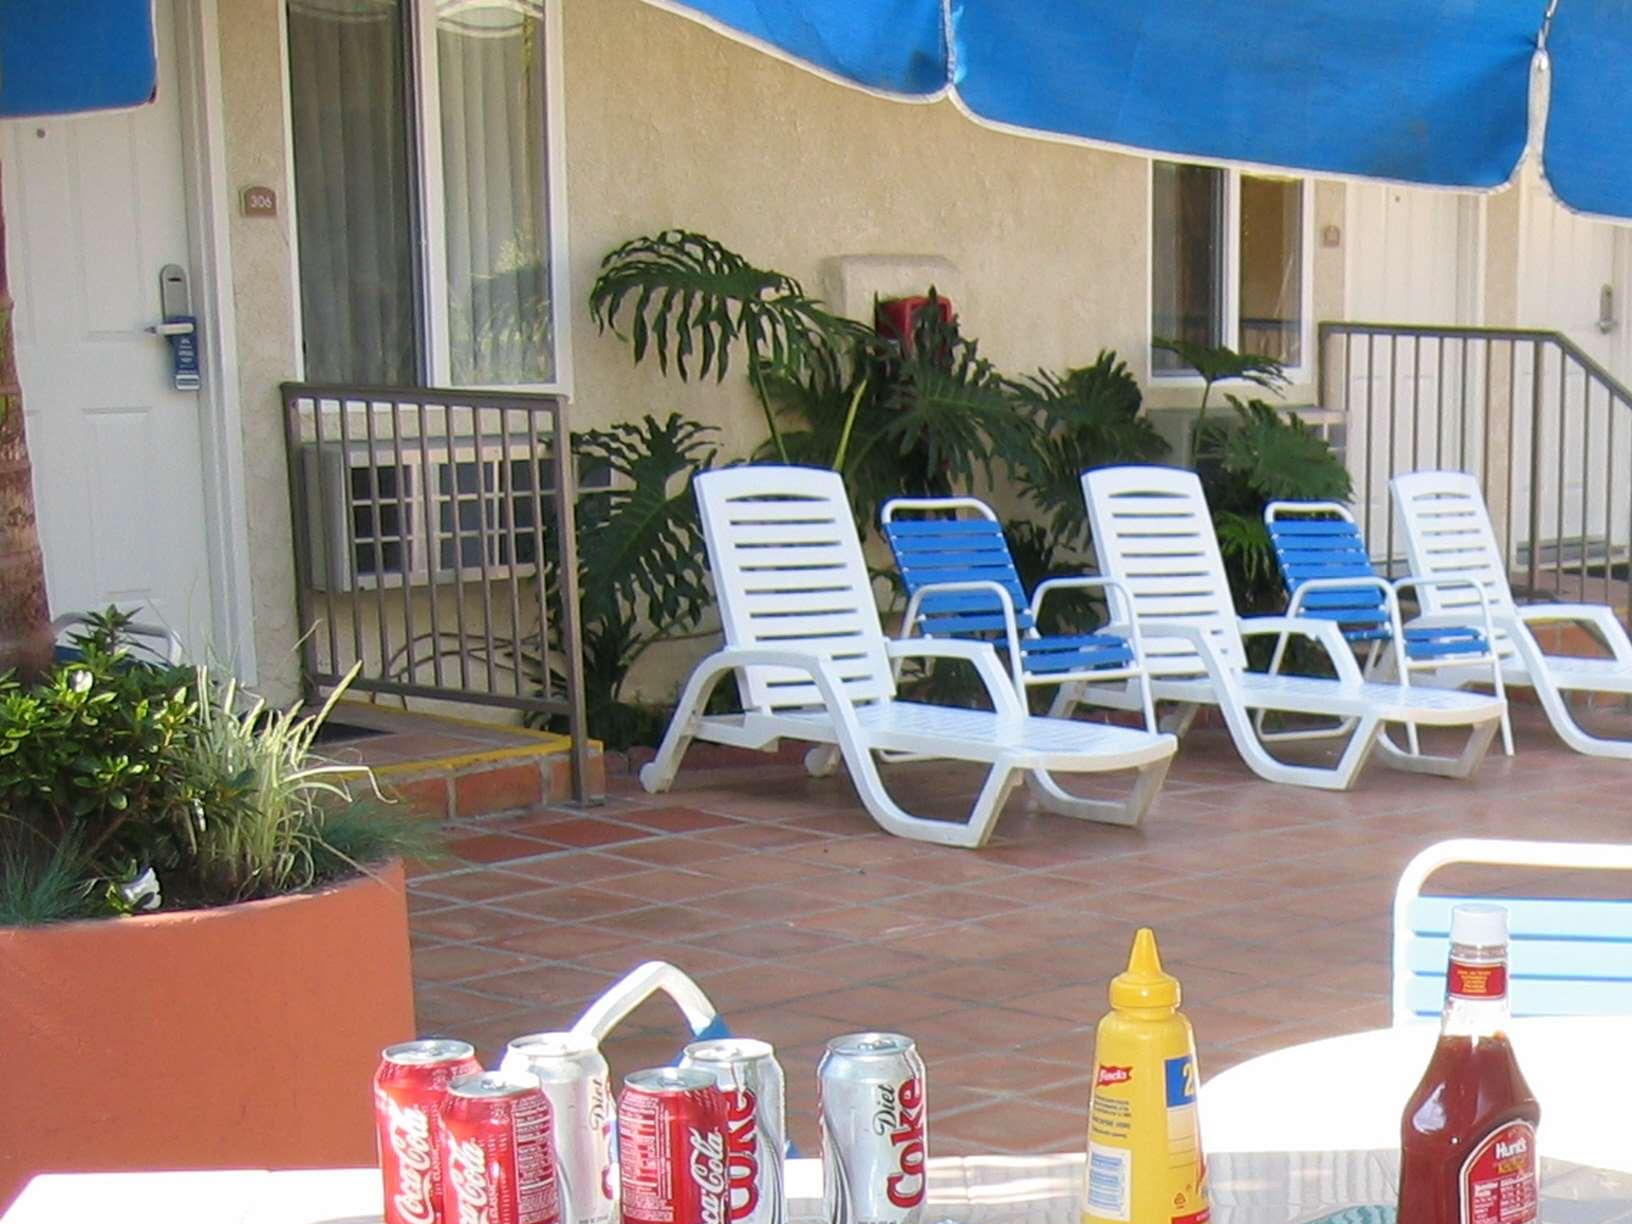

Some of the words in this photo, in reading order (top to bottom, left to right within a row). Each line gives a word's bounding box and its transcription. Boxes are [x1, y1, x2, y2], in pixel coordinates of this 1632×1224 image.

[250, 195, 273, 208] 306
[872, 1083, 896, 1137] Diet
[887, 1078, 923, 1210] Coke
